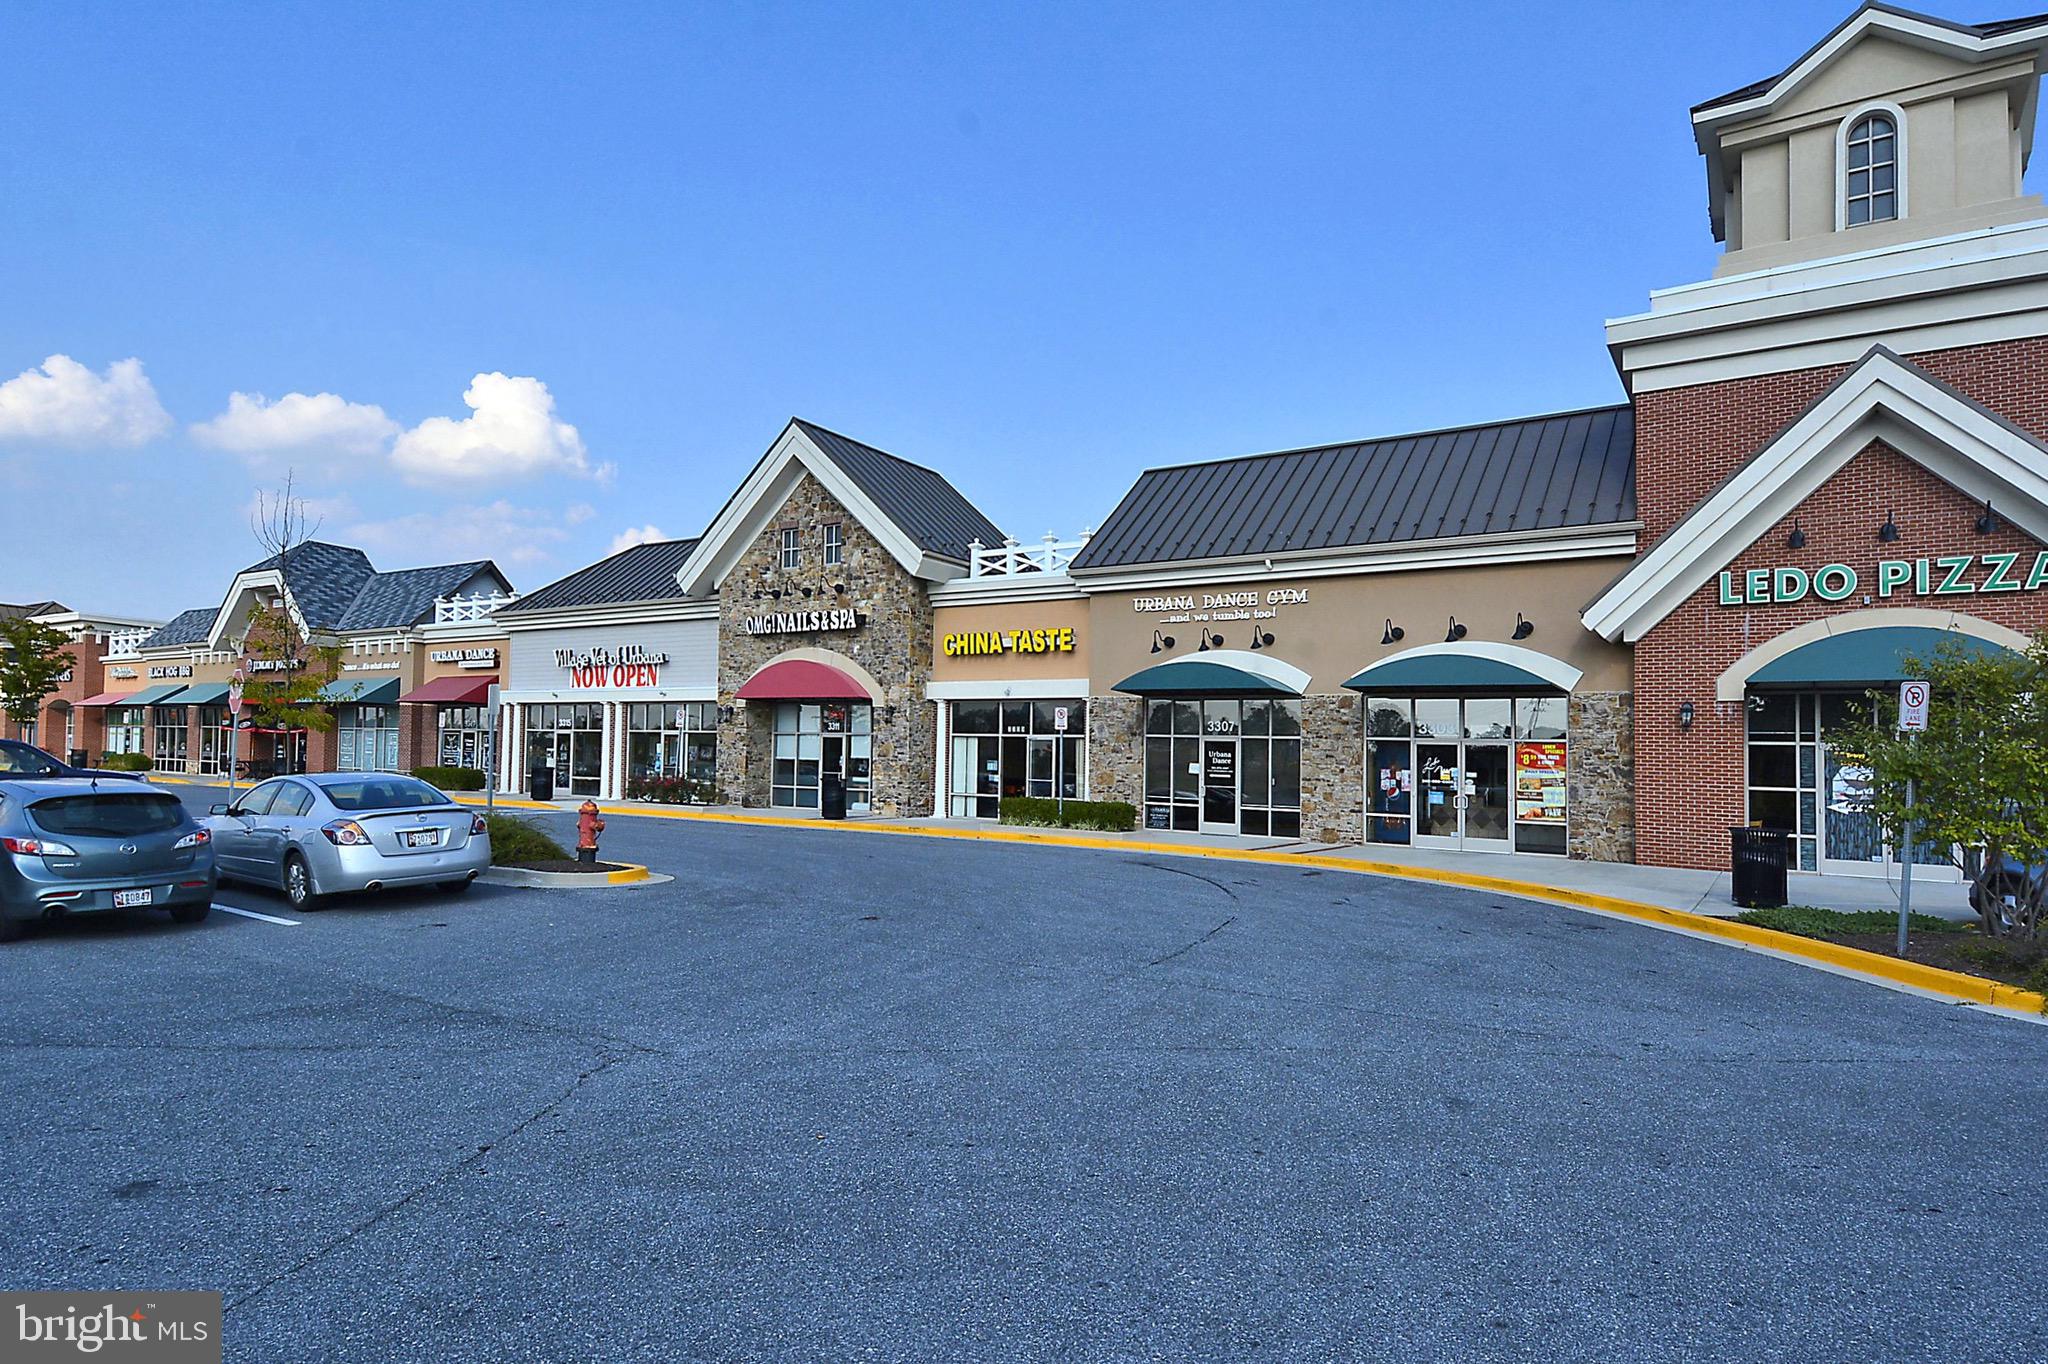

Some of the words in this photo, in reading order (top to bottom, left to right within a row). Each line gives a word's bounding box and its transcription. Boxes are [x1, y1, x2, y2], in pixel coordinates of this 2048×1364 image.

[1719, 563, 1858, 605] LEDO
[1879, 551, 2048, 598] PIZZA
[1133, 595, 1196, 612] URBANA
[1202, 592, 1259, 609] DANCE
[1267, 589, 1308, 605] GYM
[1193, 613, 1209, 622] we
[1213, 609, 1250, 620] tumble
[1254, 607, 1277, 618] too!
[943, 632, 1003, 656] CHINA
[1008, 628, 1073, 653] TASTE
[431, 650, 464, 661] URBANA
[465, 648, 495, 660] DANCE
[553, 649, 589, 670] Village
[592, 647, 607, 665] Vet
[609, 646, 623, 665] of
[624, 645, 664, 664] Urbana
[165, 667, 177, 677] HOG
[572, 665, 608, 688] NOW
[613, 664, 658, 688] OPEN
[1207, 720, 1235, 732] 3307
[1208, 750, 1232, 758] Urbana
